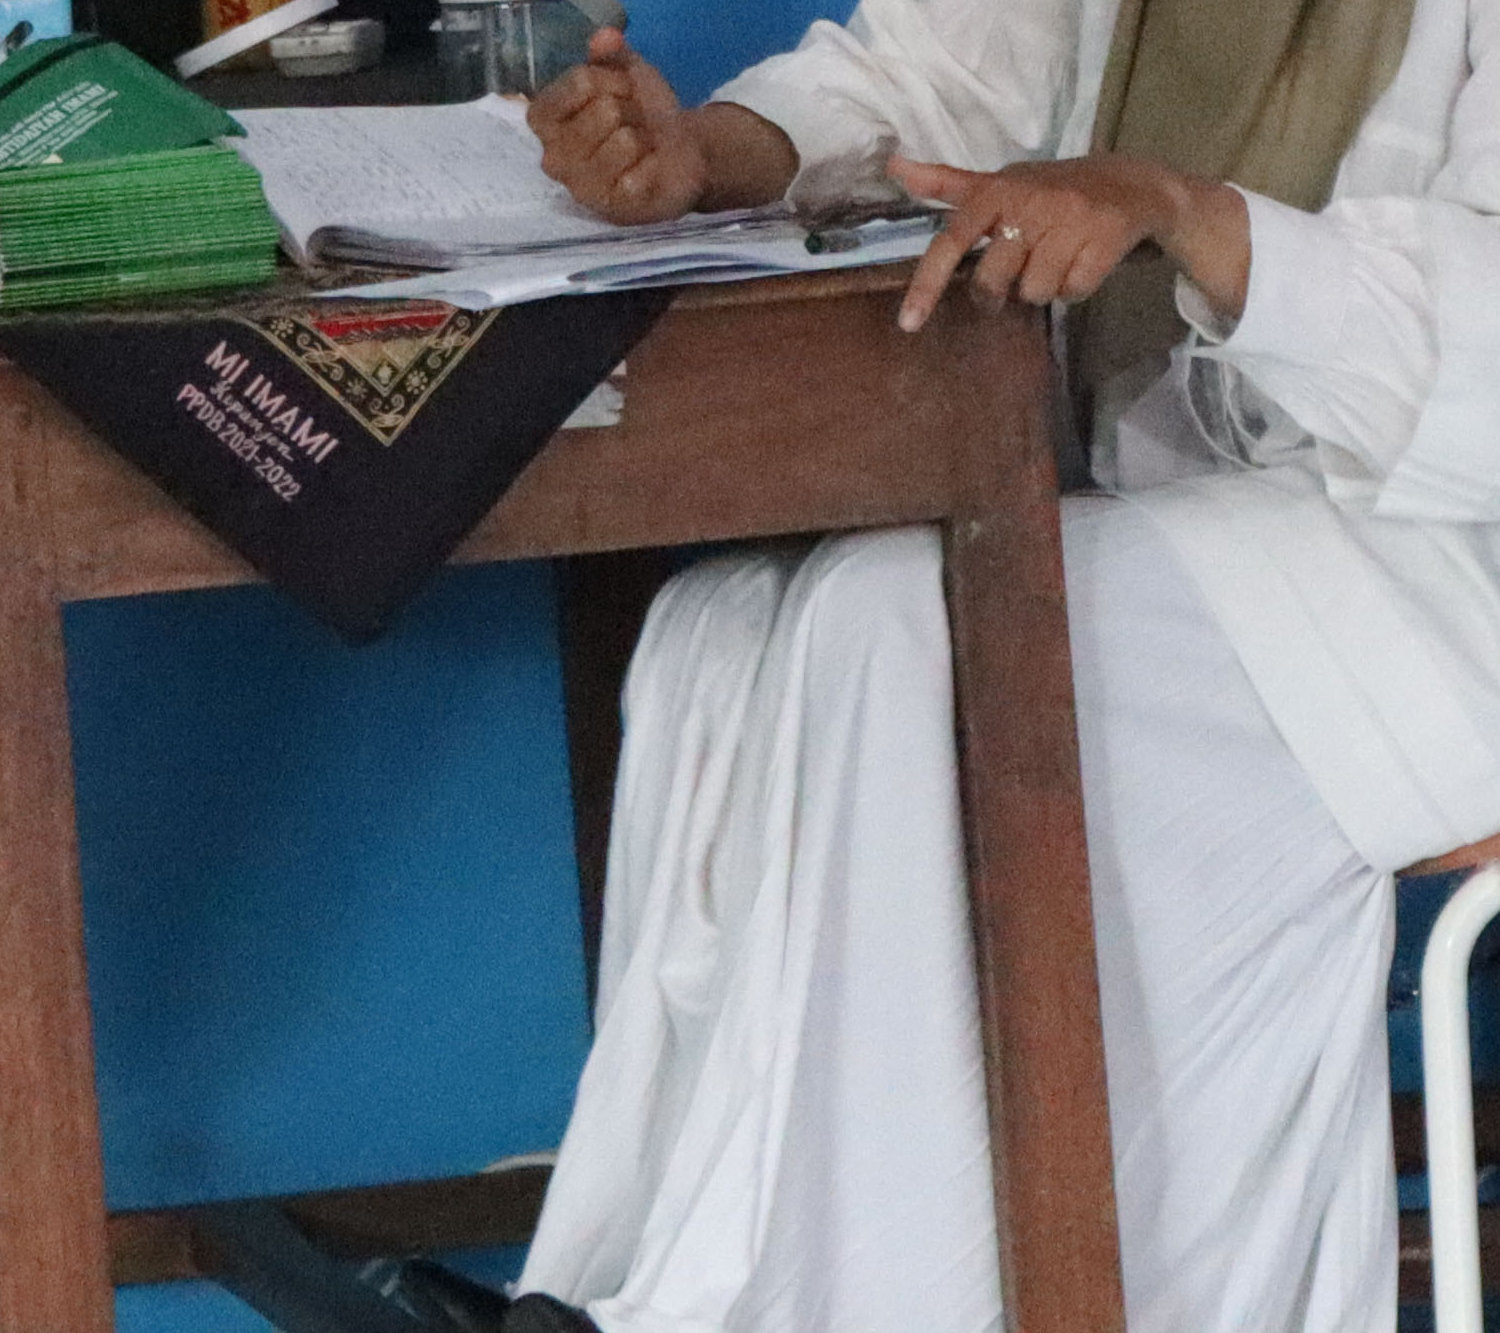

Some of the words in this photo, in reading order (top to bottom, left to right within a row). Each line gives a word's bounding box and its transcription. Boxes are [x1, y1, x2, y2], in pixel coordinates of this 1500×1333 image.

[176, 383, 226, 432] PPDB
[204, 340, 250, 384] MI
[243, 373, 340, 465] IMAMI
